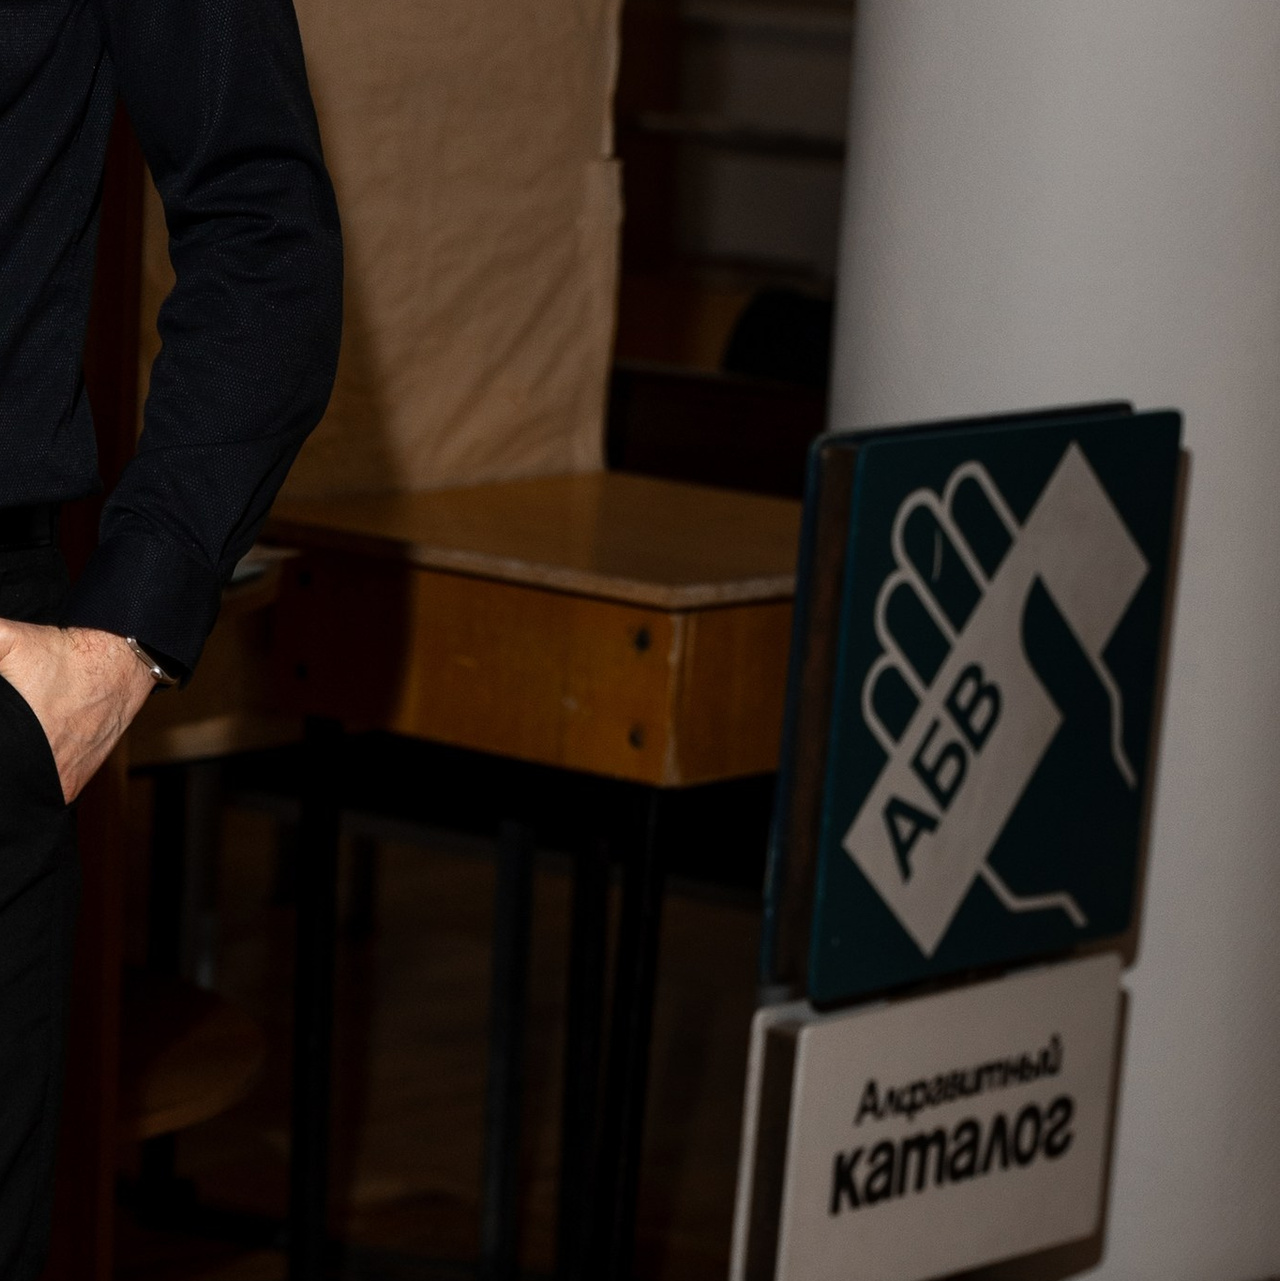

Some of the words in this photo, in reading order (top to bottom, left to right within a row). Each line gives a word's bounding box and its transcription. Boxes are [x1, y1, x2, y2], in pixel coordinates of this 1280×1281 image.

[883, 662, 1002, 884] АБВ
[854, 1033, 1063, 1126] Алфавитный
[829, 1096, 1075, 1219] каталог
